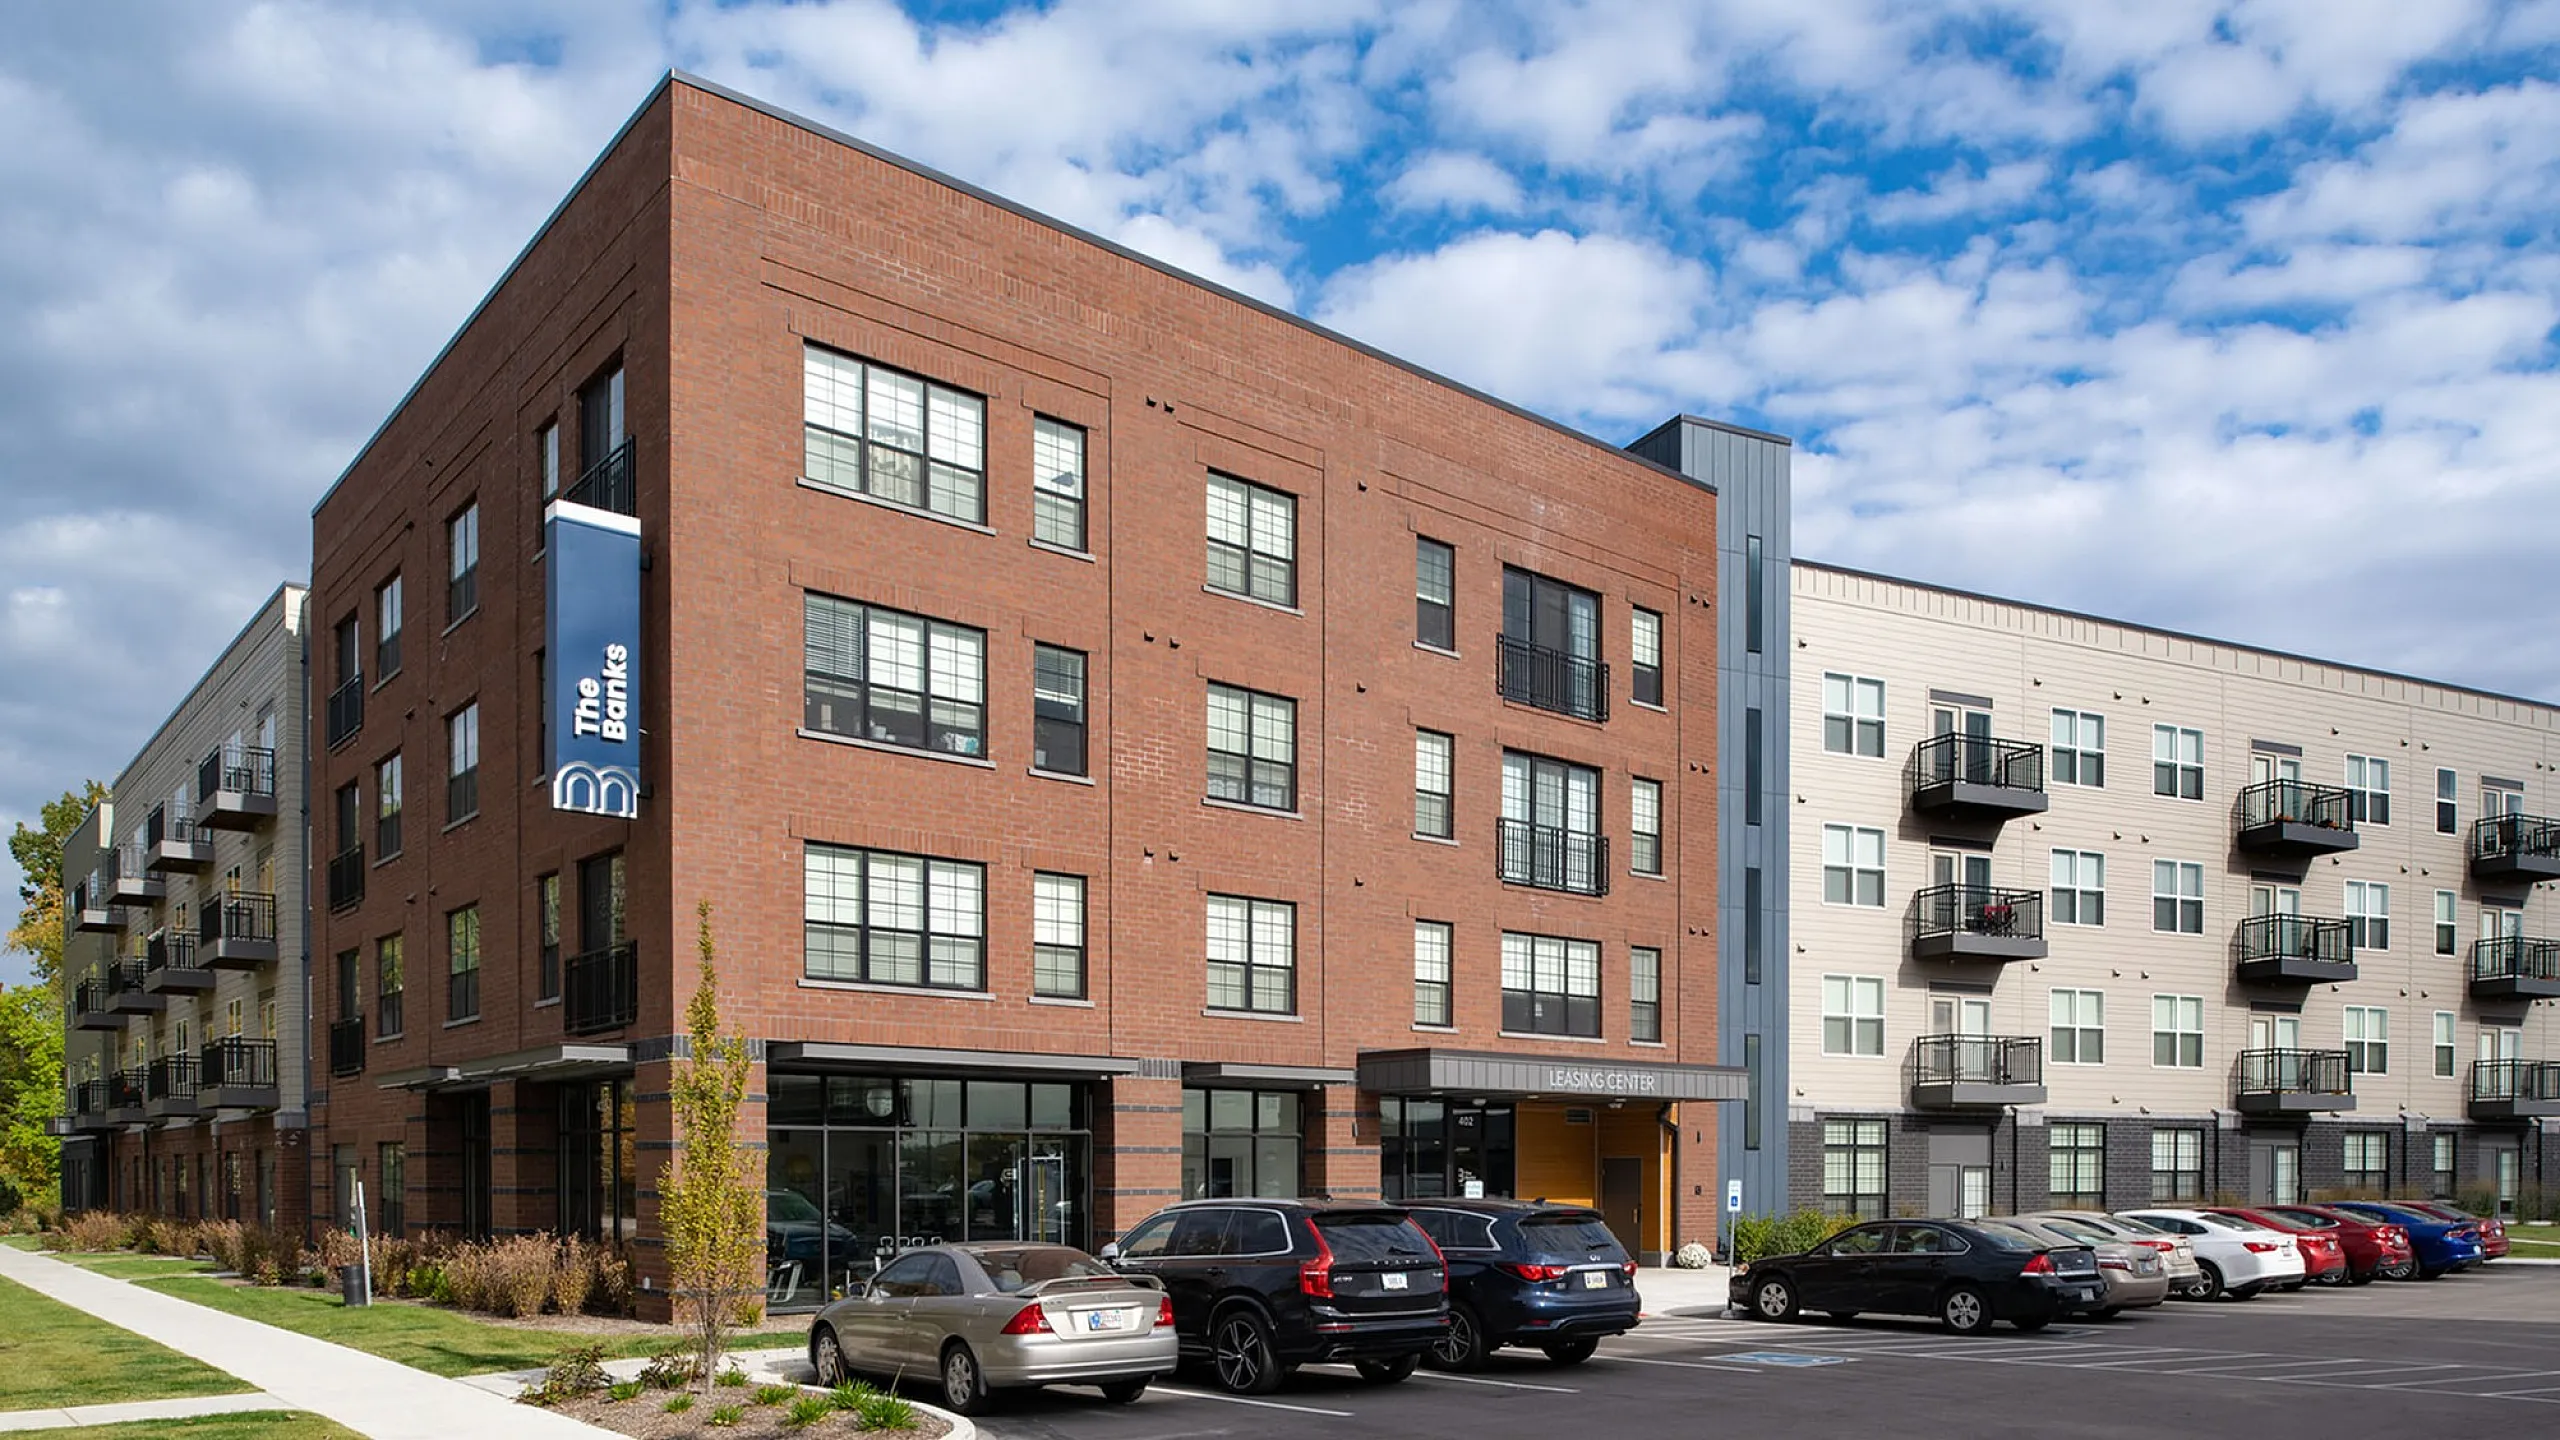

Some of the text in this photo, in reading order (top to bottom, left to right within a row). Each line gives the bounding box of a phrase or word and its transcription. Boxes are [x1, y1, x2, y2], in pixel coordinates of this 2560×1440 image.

[575, 678, 600, 735] The
[602, 643, 627, 740] Banks
[1549, 1070, 1655, 1091] LEASING CENTER
